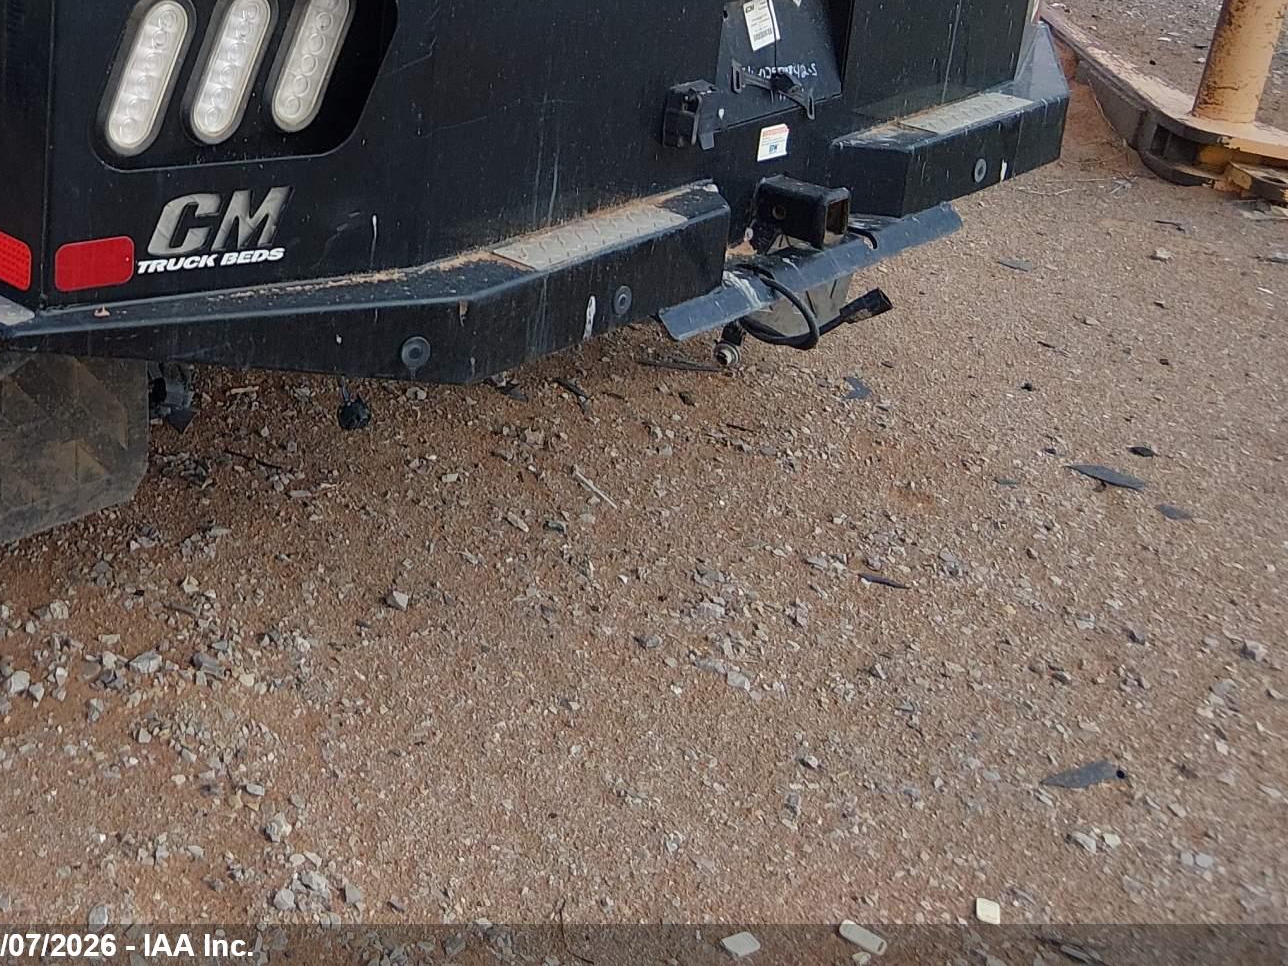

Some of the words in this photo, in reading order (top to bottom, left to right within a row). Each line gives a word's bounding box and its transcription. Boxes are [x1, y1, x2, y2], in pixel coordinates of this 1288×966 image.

[148, 186, 295, 256] CM
[136, 253, 219, 275] TRUCK
[220, 247, 286, 266] BEDS
